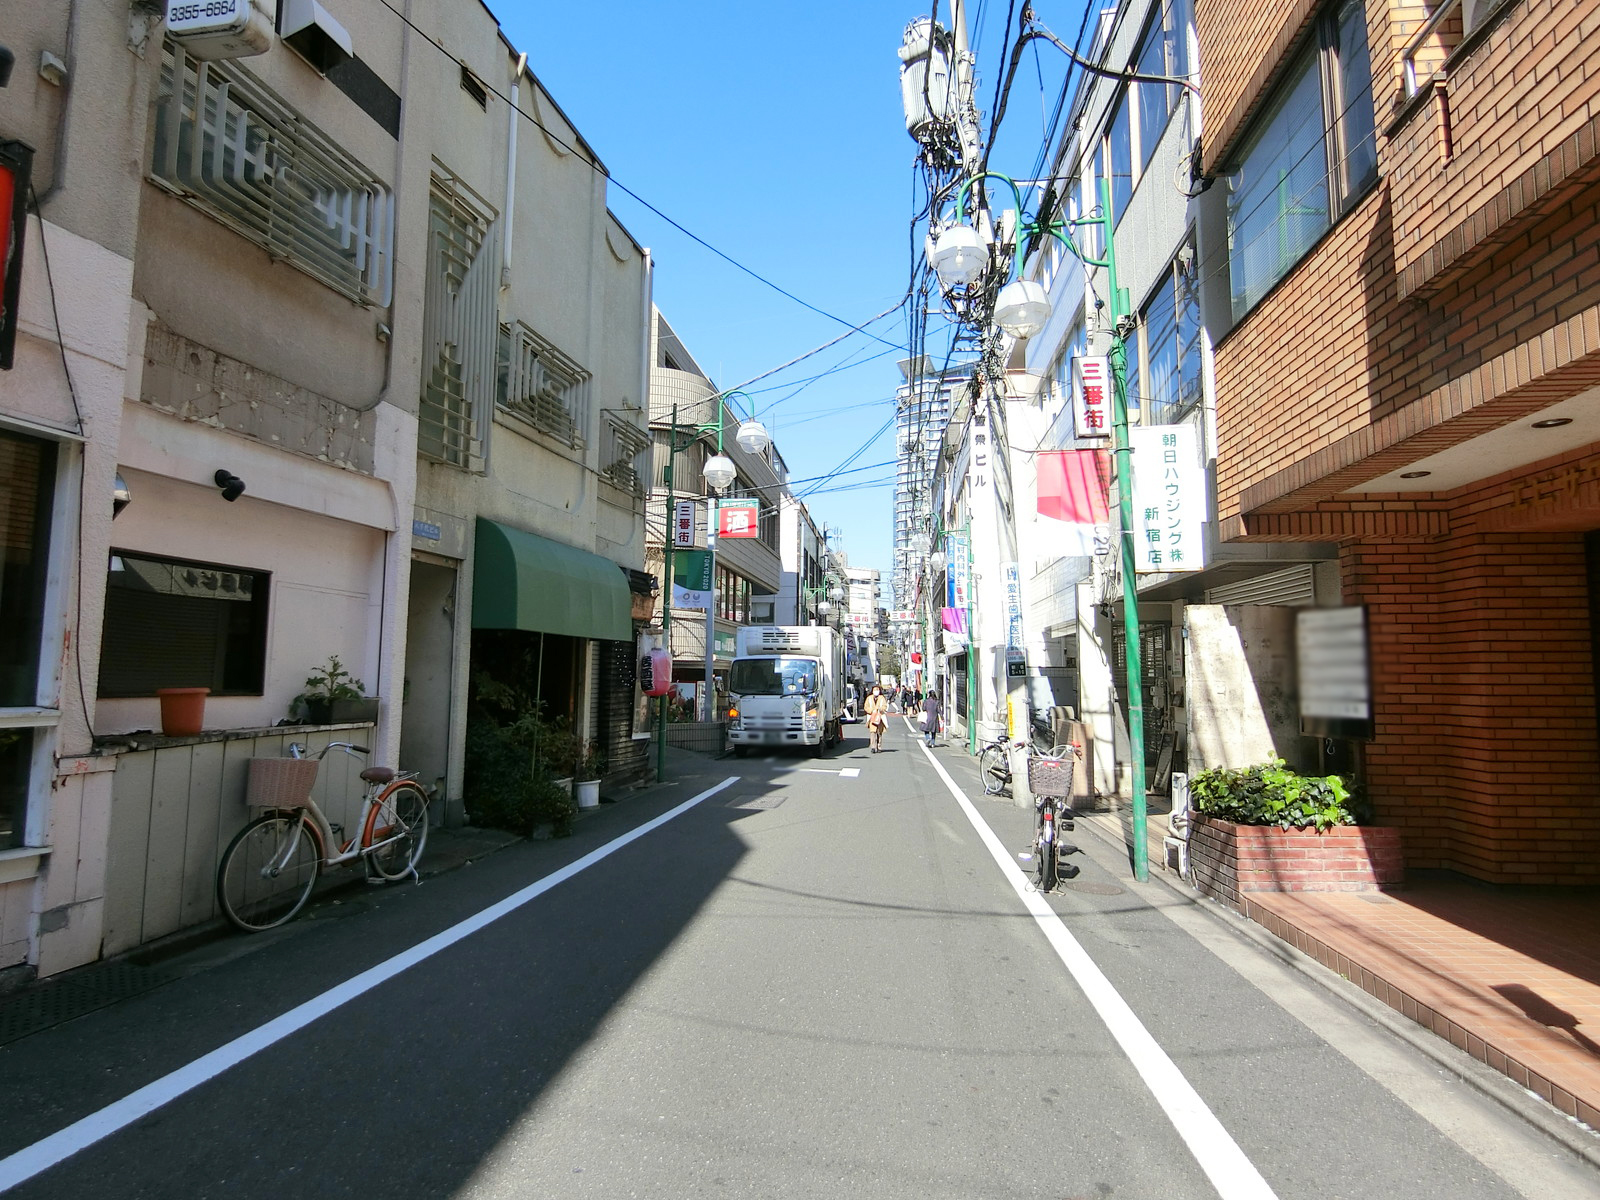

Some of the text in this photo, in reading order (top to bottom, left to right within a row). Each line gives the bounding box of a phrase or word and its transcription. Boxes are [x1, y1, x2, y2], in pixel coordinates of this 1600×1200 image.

[169, 0, 236, 22] 3355-6664
[1081, 362, 1105, 430] 三番街
[678, 506, 691, 543] 三番街
[726, 510, 749, 534] 酒
[1143, 506, 1162, 564] 新宿店
